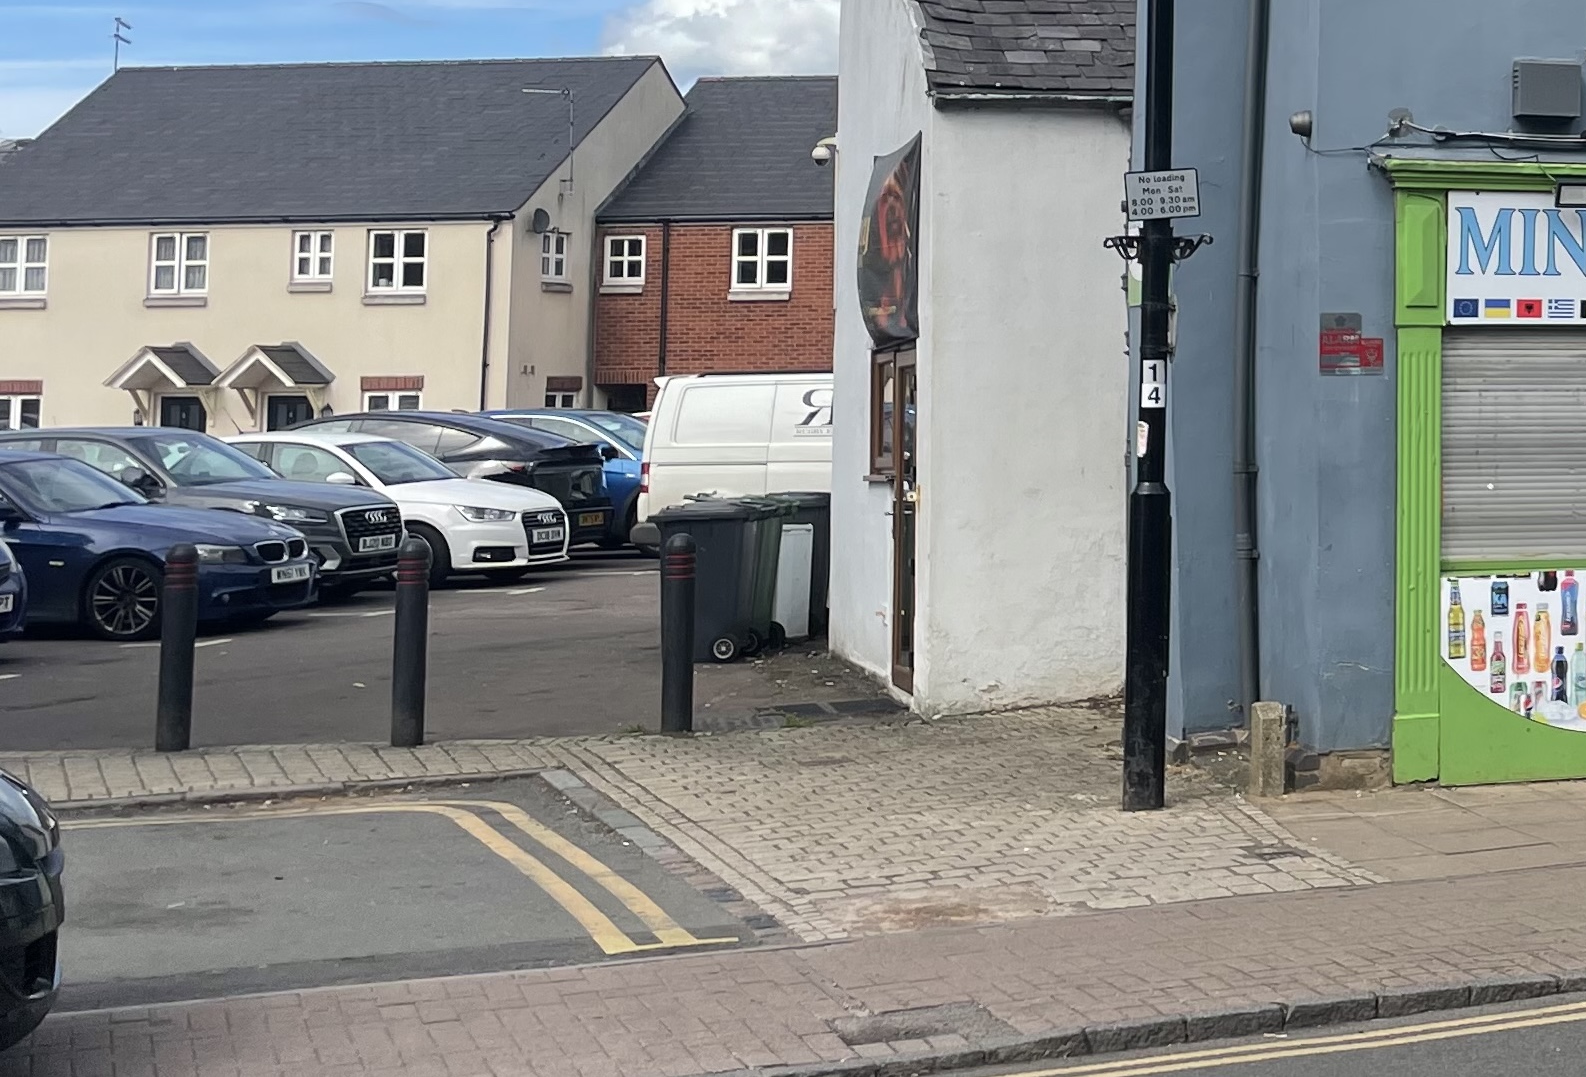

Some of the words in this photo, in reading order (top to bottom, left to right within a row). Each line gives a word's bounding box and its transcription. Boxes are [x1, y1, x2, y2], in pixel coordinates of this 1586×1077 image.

[1138, 176, 1151, 184] No
[1153, 174, 1185, 183] loading
[1142, 187, 1161, 195] Mon
[1167, 185, 1184, 194] Sat
[1131, 198, 1153, 207] 8.00
[1159, 196, 1181, 205] 9.30
[1160, 205, 1181, 214] 6.00
[1182, 206, 1197, 214] pm
[1148, 363, 1157, 382] 1
[1148, 387, 1161, 404] 4
